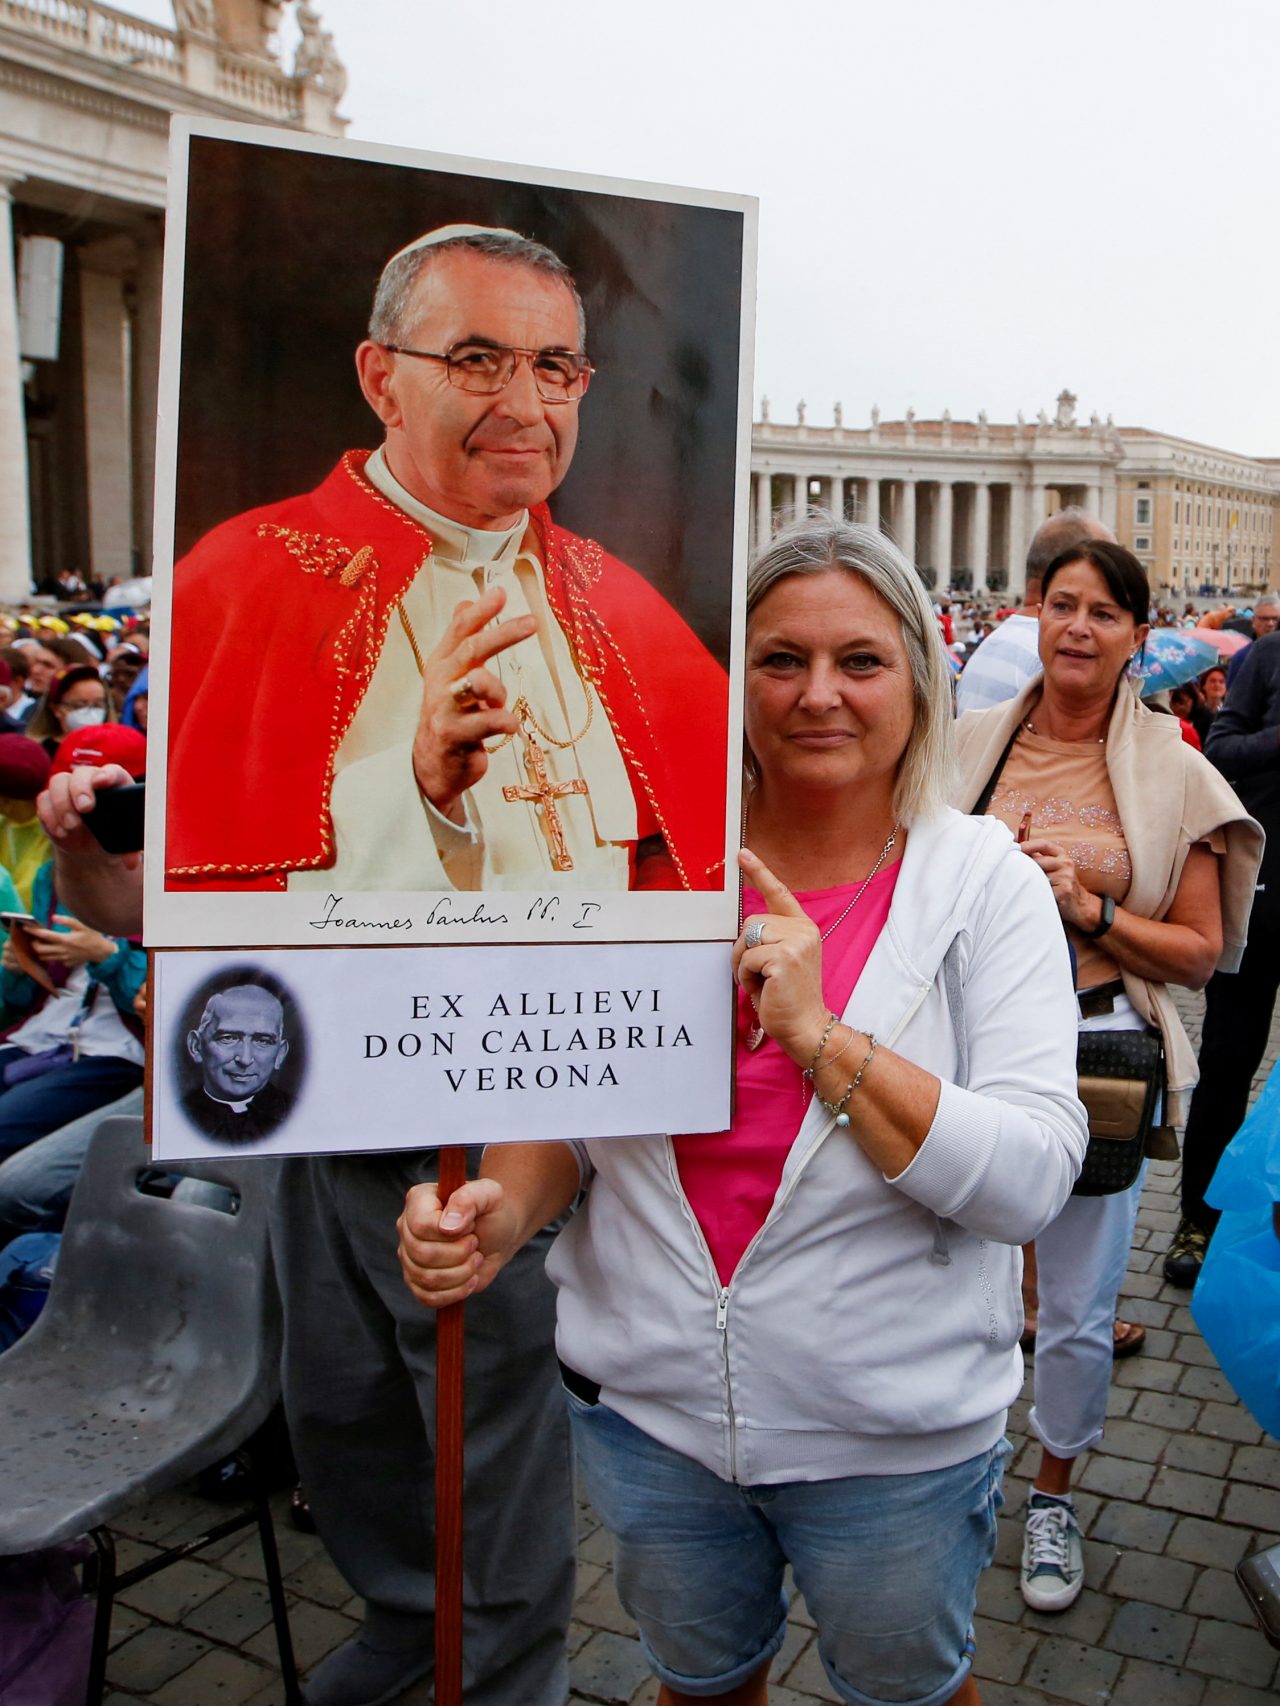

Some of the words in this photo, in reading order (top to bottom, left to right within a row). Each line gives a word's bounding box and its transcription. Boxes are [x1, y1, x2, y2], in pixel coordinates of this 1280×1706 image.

[411, 995, 465, 1020] EX
[487, 989, 661, 1017] ALLIEVI
[363, 1031, 456, 1059] DON
[481, 1024, 694, 1054] CALABRIA
[443, 1063, 620, 1093] VERONA
